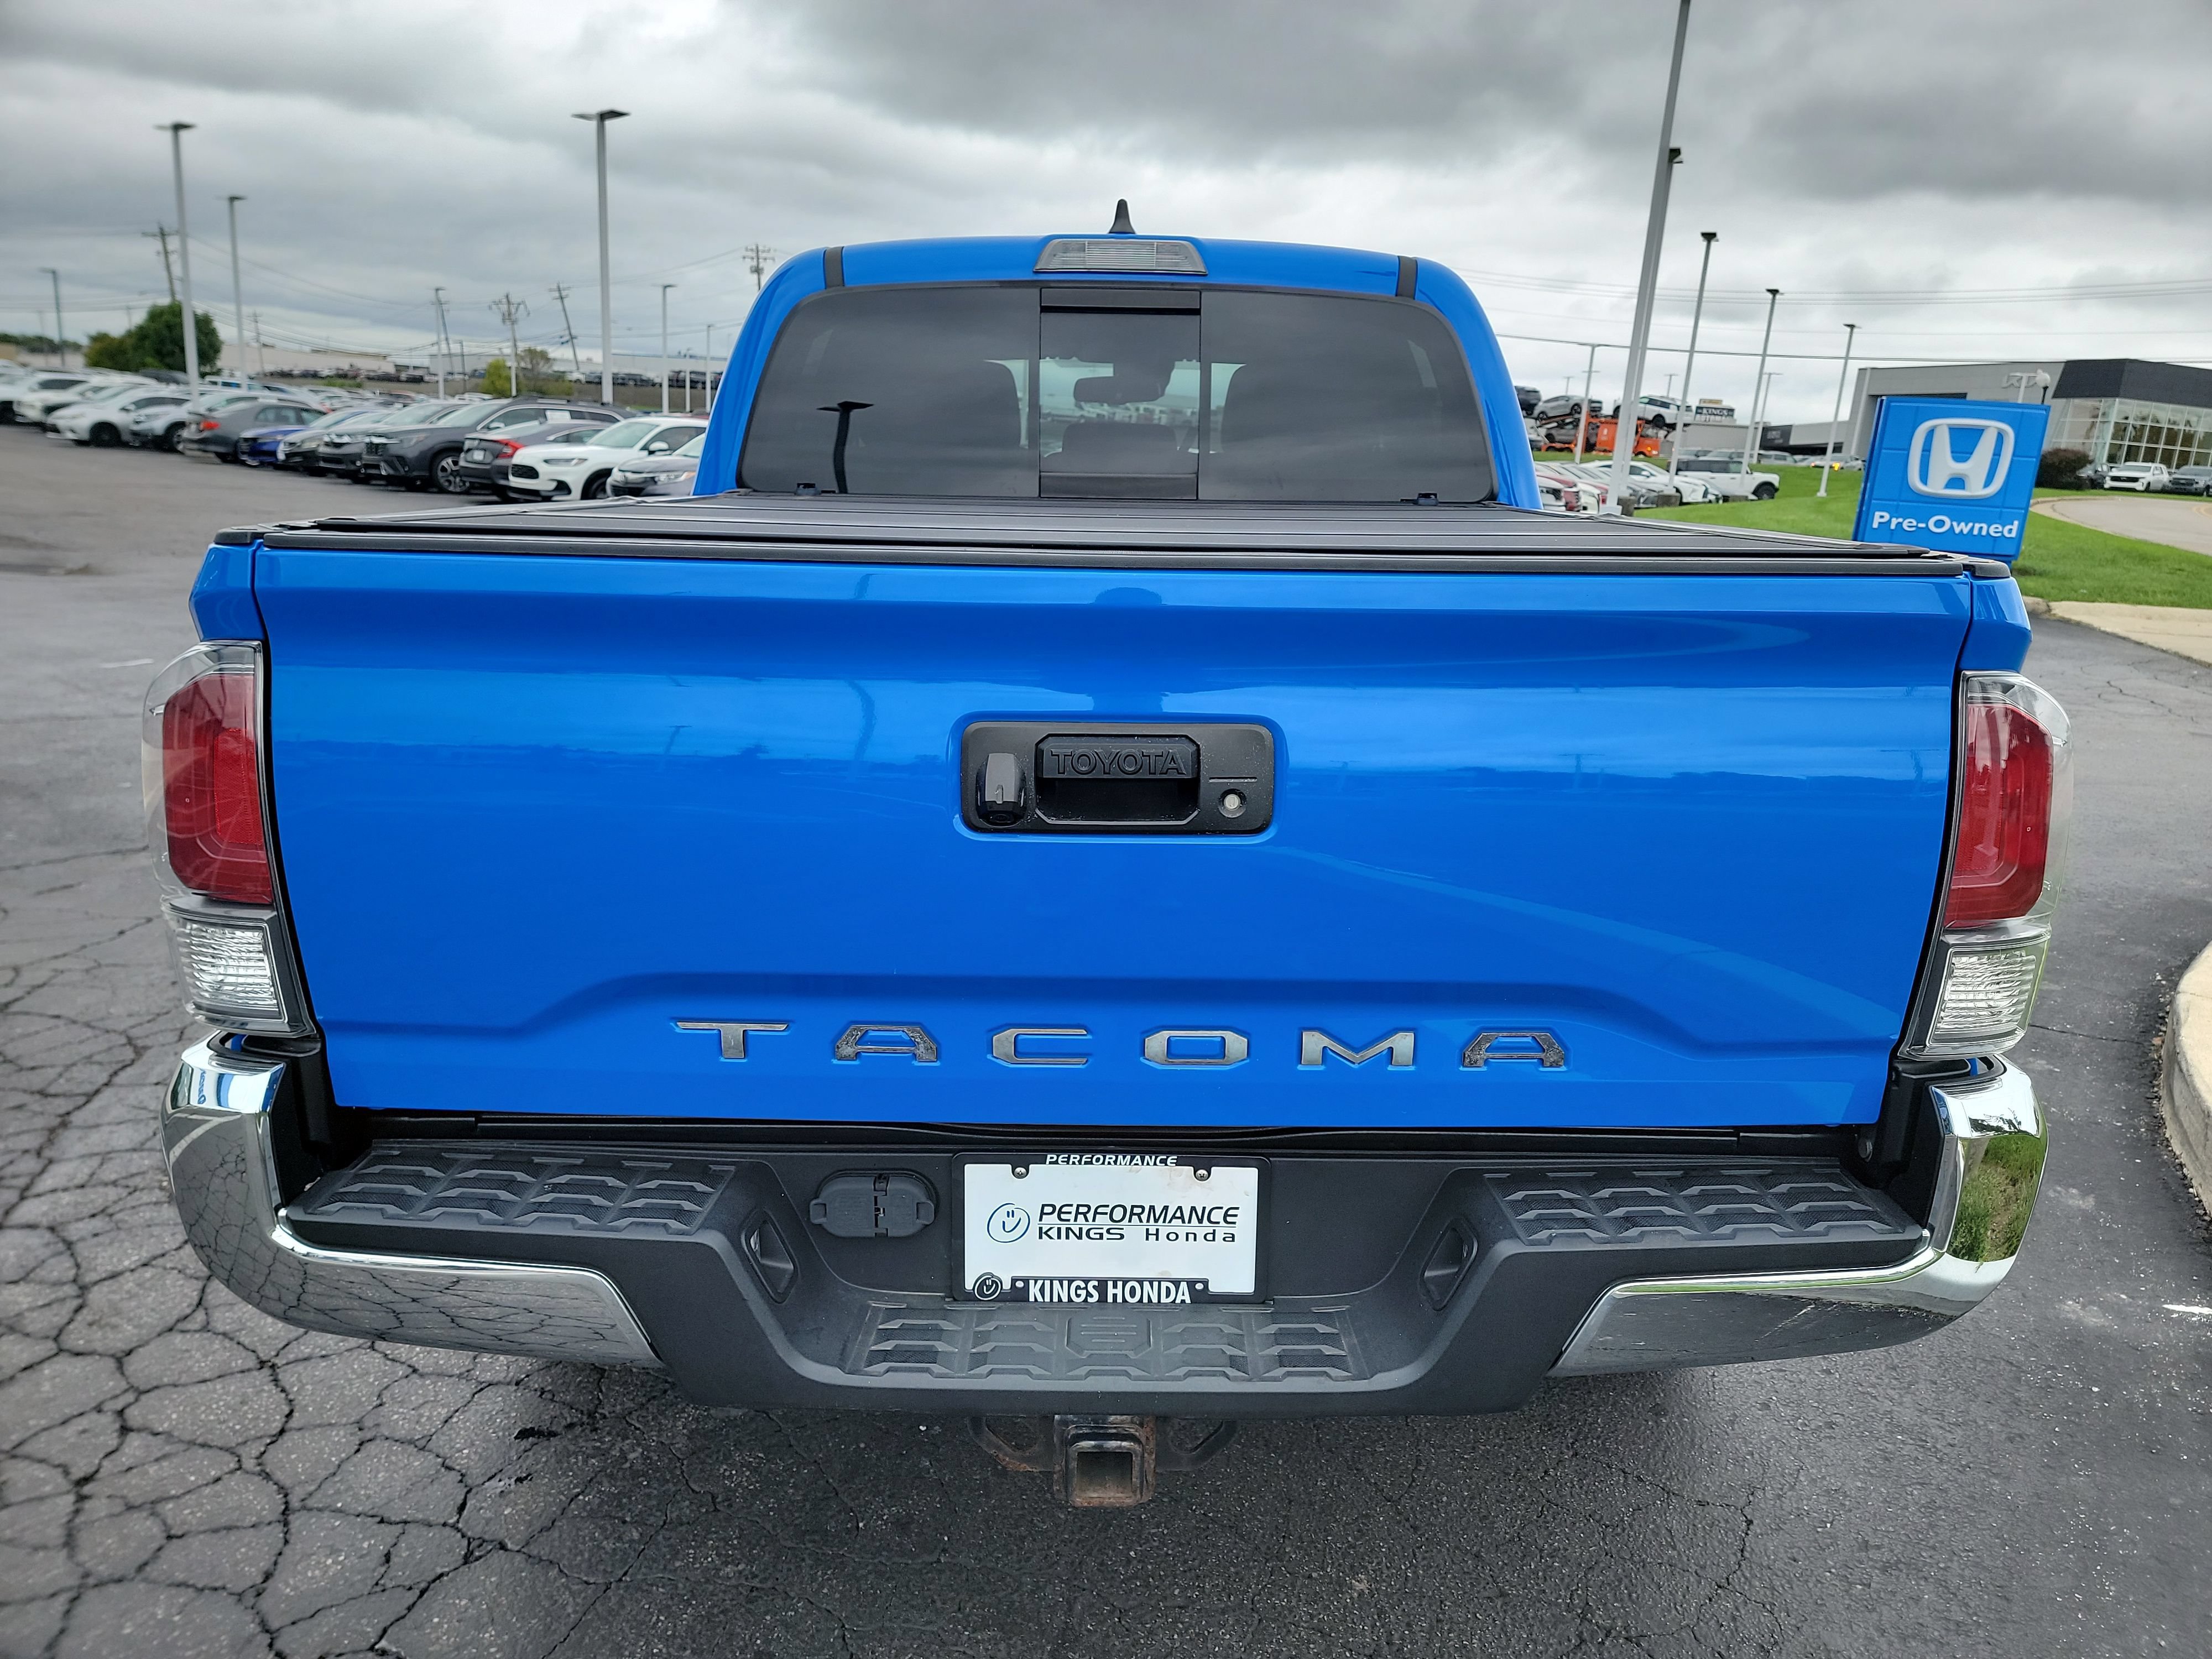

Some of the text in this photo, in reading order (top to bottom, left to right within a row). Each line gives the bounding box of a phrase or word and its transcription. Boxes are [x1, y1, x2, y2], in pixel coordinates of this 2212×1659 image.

[1872, 511, 2019, 538] Pre-Owned
[1051, 749, 1186, 775] TOYOTA
[676, 1021, 1564, 1067] TACOMA
[1045, 1154, 1178, 1167] PERFORMANCE
[1038, 1203, 1240, 1225] PERFORMANCE
[1038, 1227, 1236, 1243] KINGS Honda
[1029, 1280, 1192, 1304] KINGS HONDA
